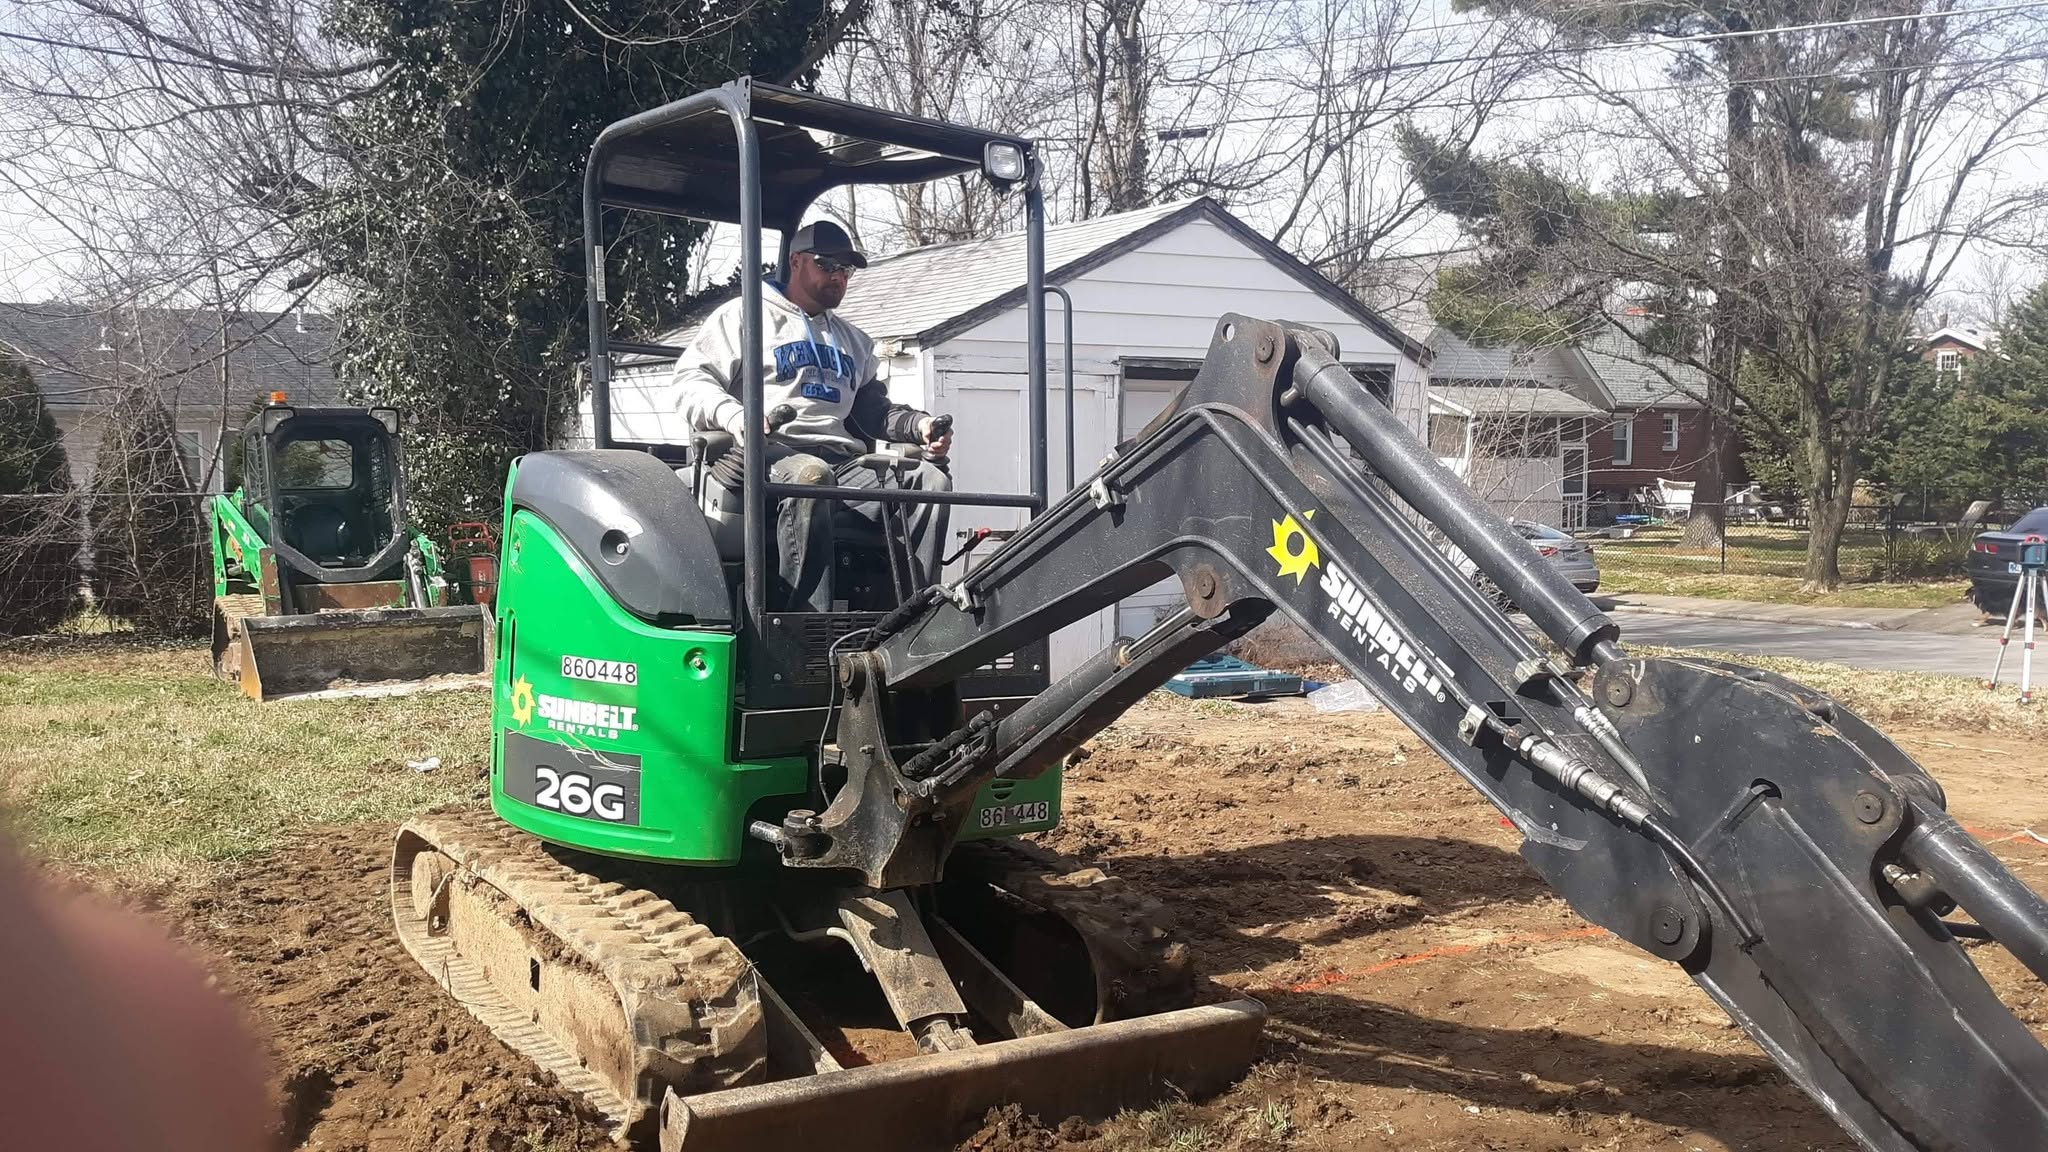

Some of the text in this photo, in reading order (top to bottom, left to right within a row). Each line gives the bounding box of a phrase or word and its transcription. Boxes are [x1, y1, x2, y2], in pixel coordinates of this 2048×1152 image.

[1327, 602, 1418, 694] RENTALS
[562, 656, 637, 684] 860448
[538, 694, 637, 731] SUNBELT
[547, 721, 619, 740] RENTALS
[535, 766, 625, 820] 26G
